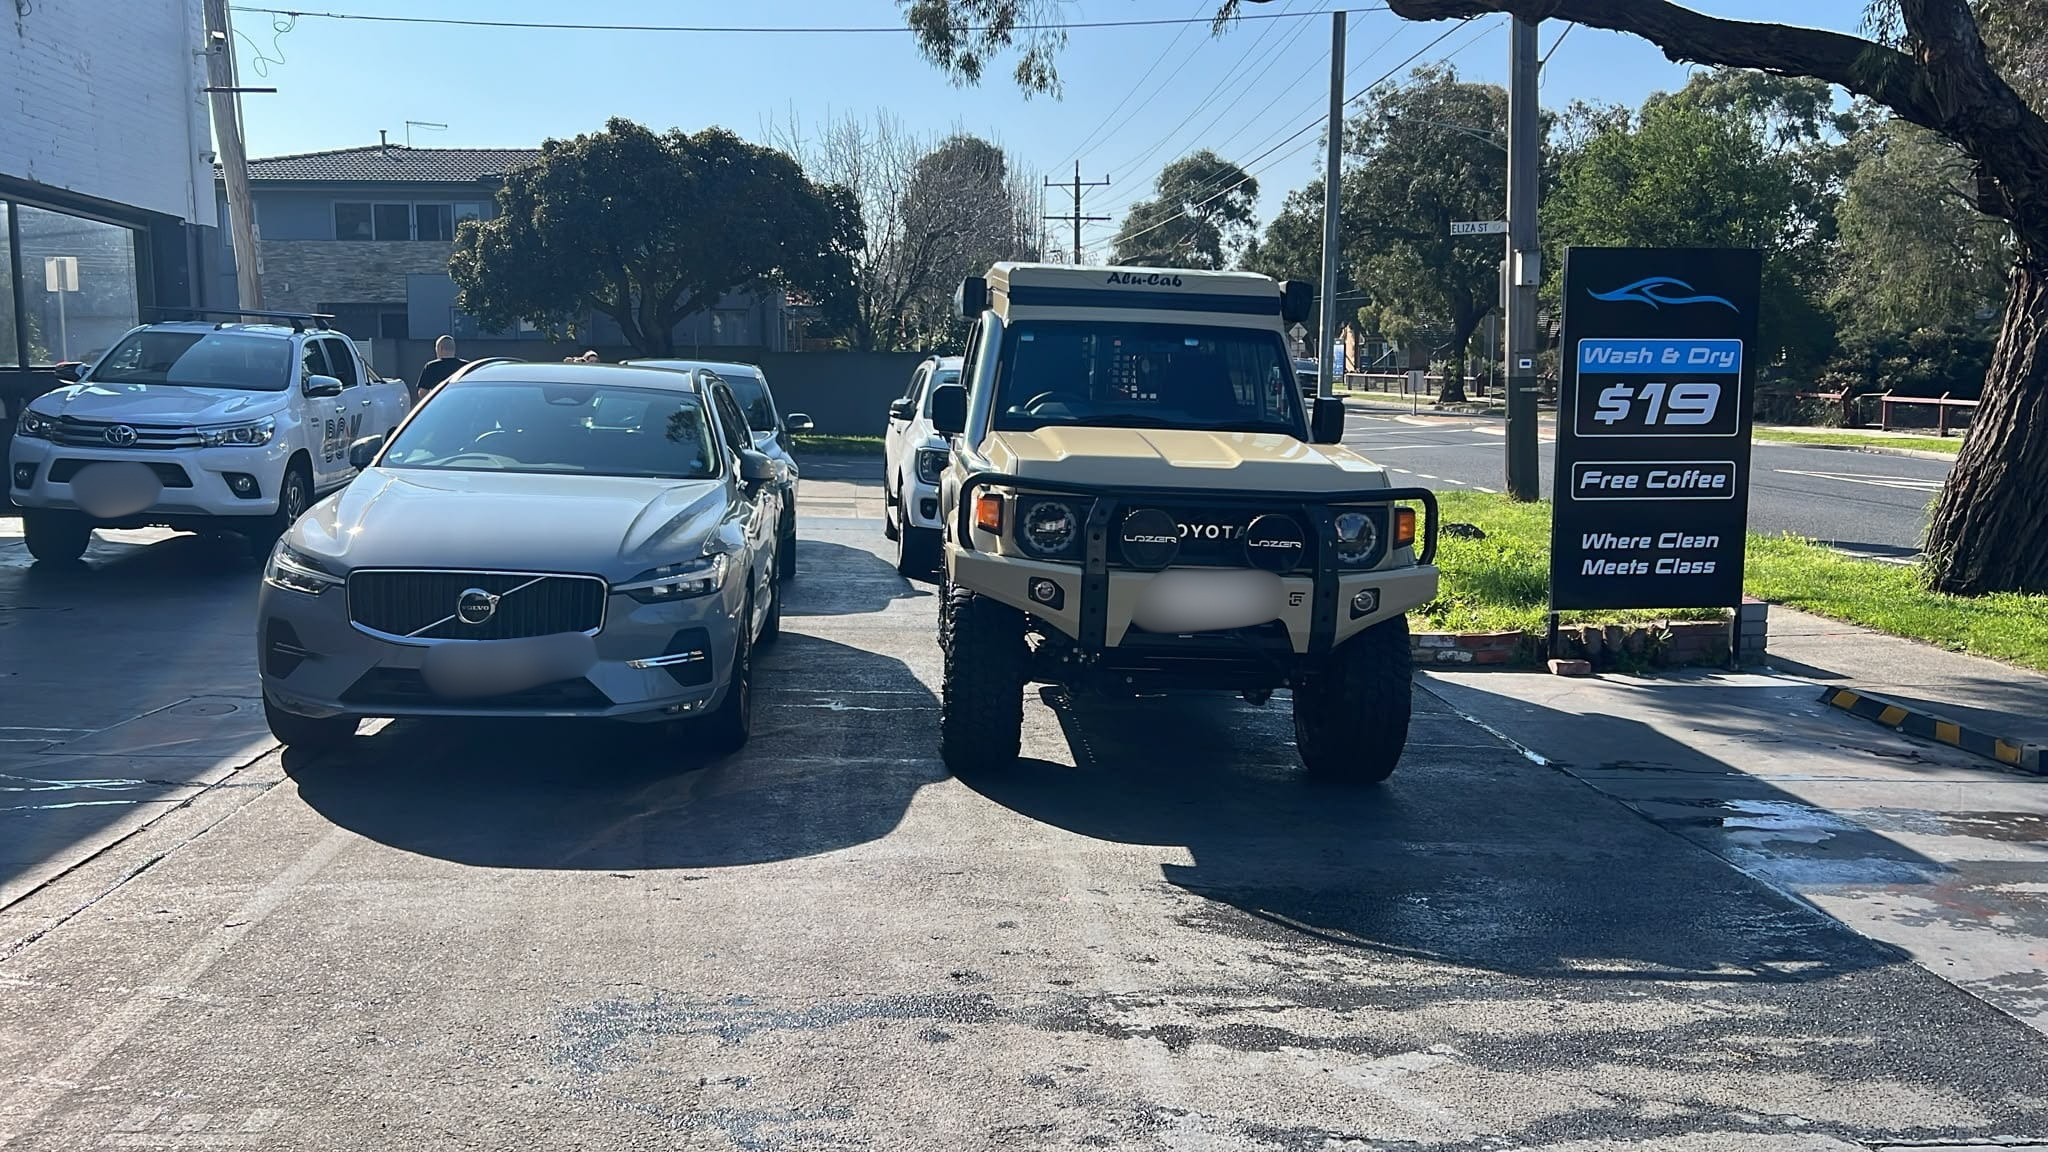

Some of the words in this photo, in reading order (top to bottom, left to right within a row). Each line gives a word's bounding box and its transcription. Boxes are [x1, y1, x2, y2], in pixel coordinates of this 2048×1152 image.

[1452, 223, 1476, 233] ELIZA
[1478, 223, 1488, 232] ST
[1107, 272, 1183, 287] Alu-Cab
[1583, 347, 1652, 364] Wash
[1661, 347, 1680, 364] &
[1687, 348, 1735, 368] Dry
[1594, 383, 1721, 425] $19
[1580, 471, 1639, 489] Free
[1646, 470, 1726, 489] Coffee
[1177, 524, 1245, 539] OYOTA
[1582, 533, 1651, 550] Where
[1658, 532, 1719, 549] Clean
[1581, 558, 1648, 576] Meets
[1655, 558, 1716, 574] Class
